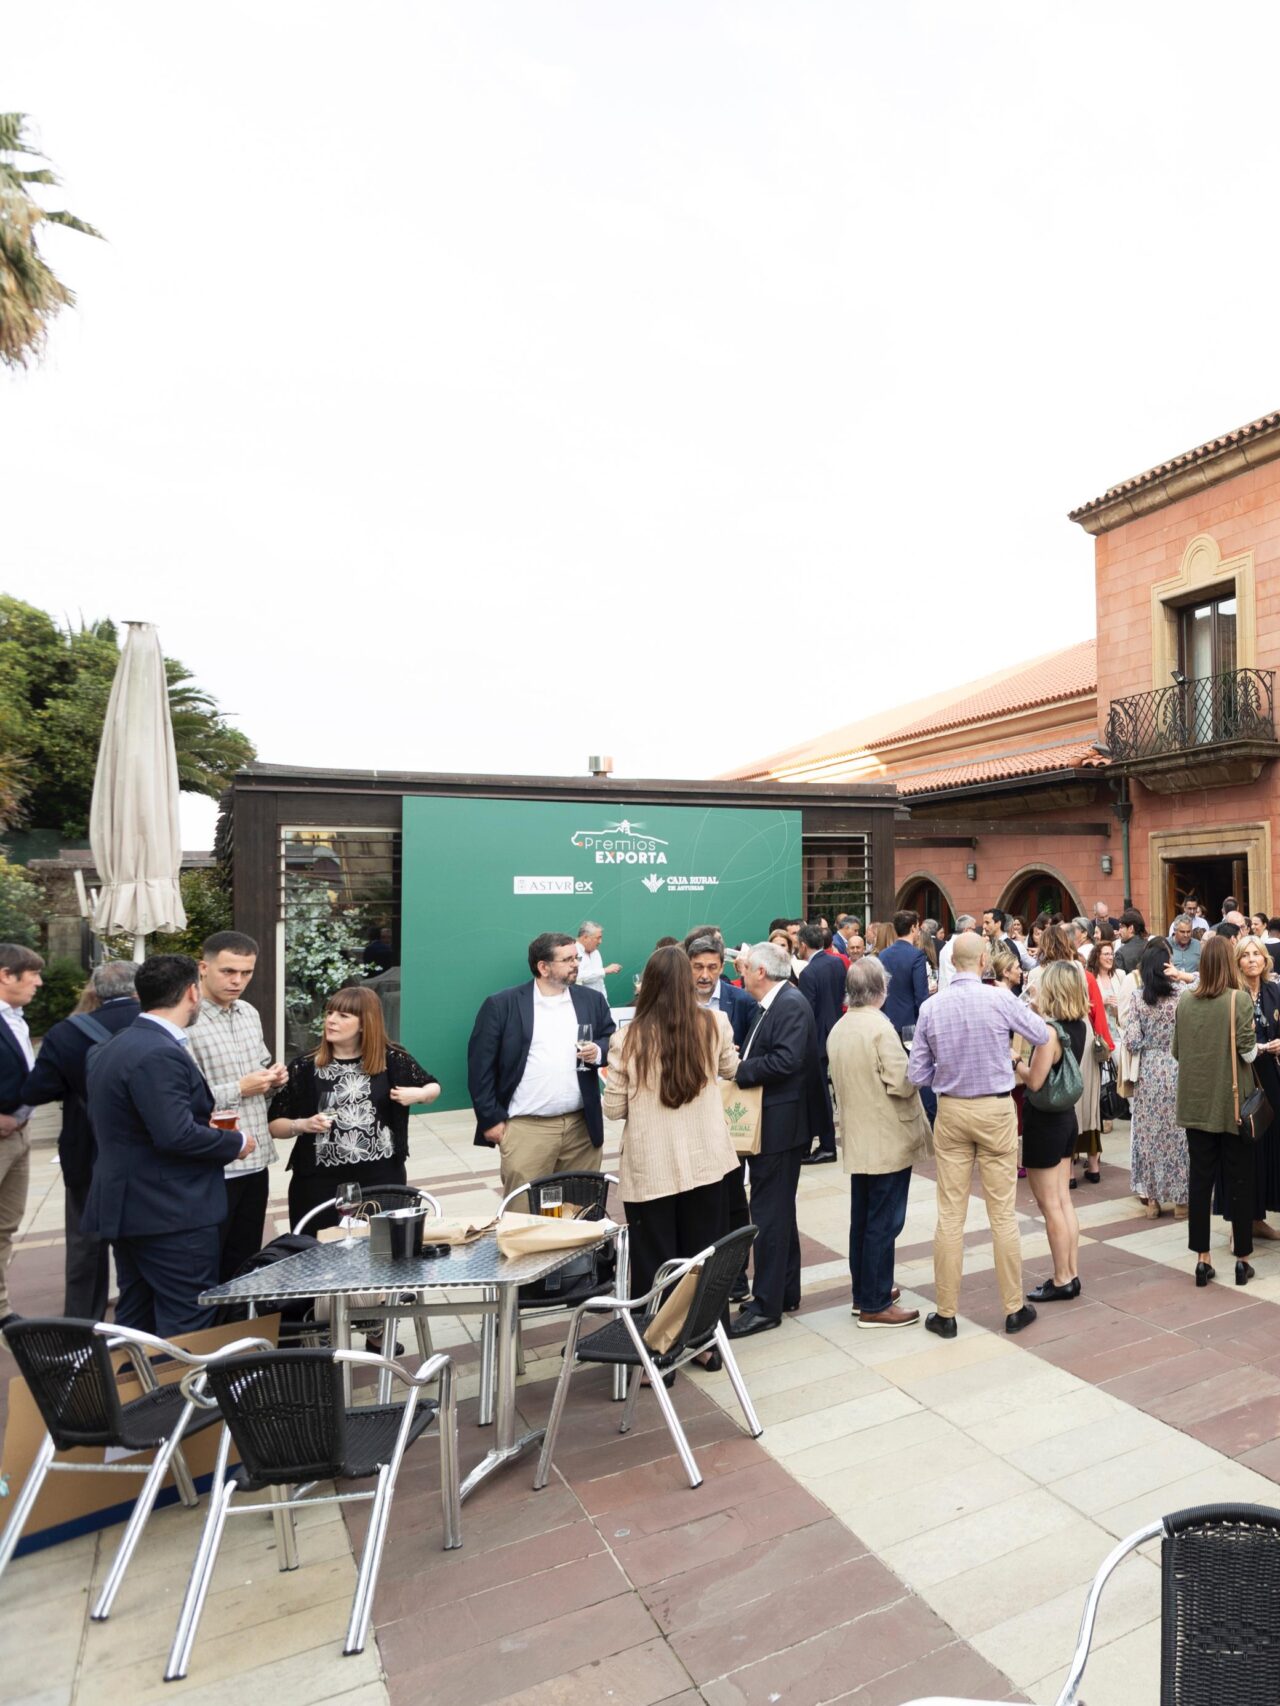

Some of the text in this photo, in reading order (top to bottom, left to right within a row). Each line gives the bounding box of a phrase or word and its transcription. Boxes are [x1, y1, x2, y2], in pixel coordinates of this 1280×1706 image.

[584, 837, 656, 851] Premios
[595, 850, 668, 864] EXPORTA
[666, 876, 720, 885] CAJA RURAL
